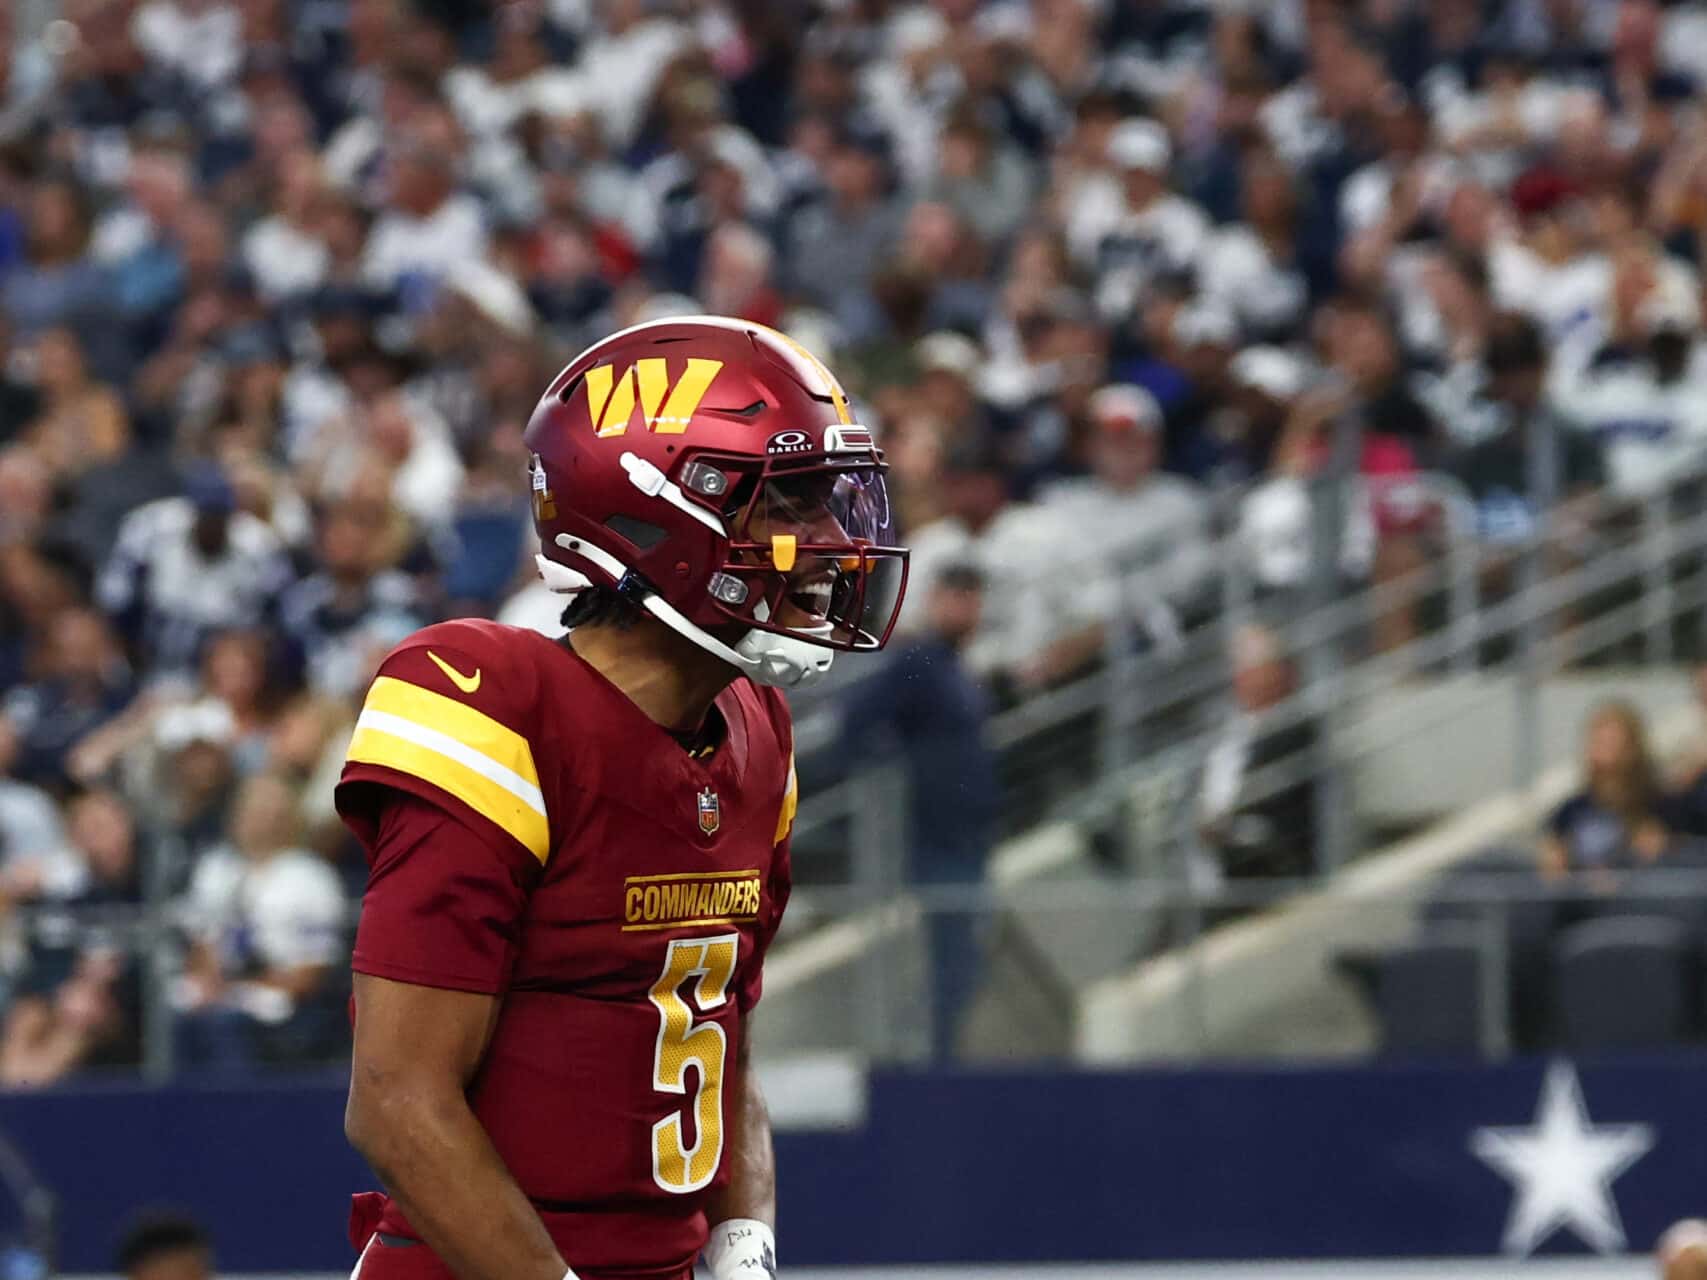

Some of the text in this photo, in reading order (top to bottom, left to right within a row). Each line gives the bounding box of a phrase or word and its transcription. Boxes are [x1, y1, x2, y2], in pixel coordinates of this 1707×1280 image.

[584, 358, 724, 438] W
[768, 444, 812, 454] OAKLEY
[625, 878, 760, 922] COMMANDERS
[648, 933, 739, 1194] 5
